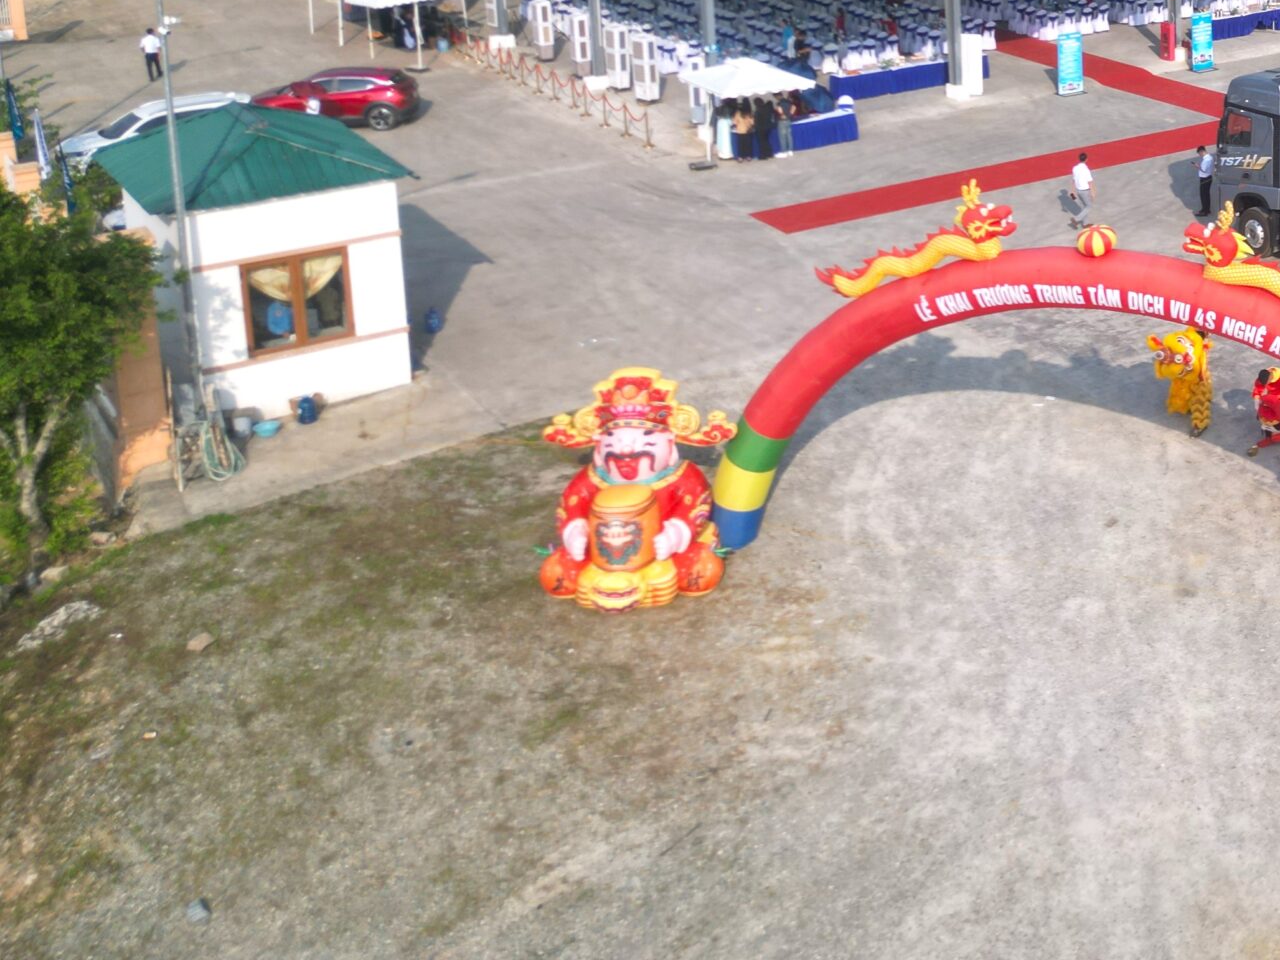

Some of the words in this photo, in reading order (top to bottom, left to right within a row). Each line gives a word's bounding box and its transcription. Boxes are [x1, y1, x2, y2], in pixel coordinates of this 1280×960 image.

[935, 291, 974, 317] KHAI
[972, 283, 1033, 309] TRƯƠNG
[1033, 283, 1085, 305] TRUNG
[1087, 283, 1122, 309] TÂM
[1127, 291, 1165, 316] DỊCH
[1169, 299, 1191, 324] VỤ
[1193, 307, 1217, 330] 4S
[1221, 316, 1267, 349] NGHỆ
